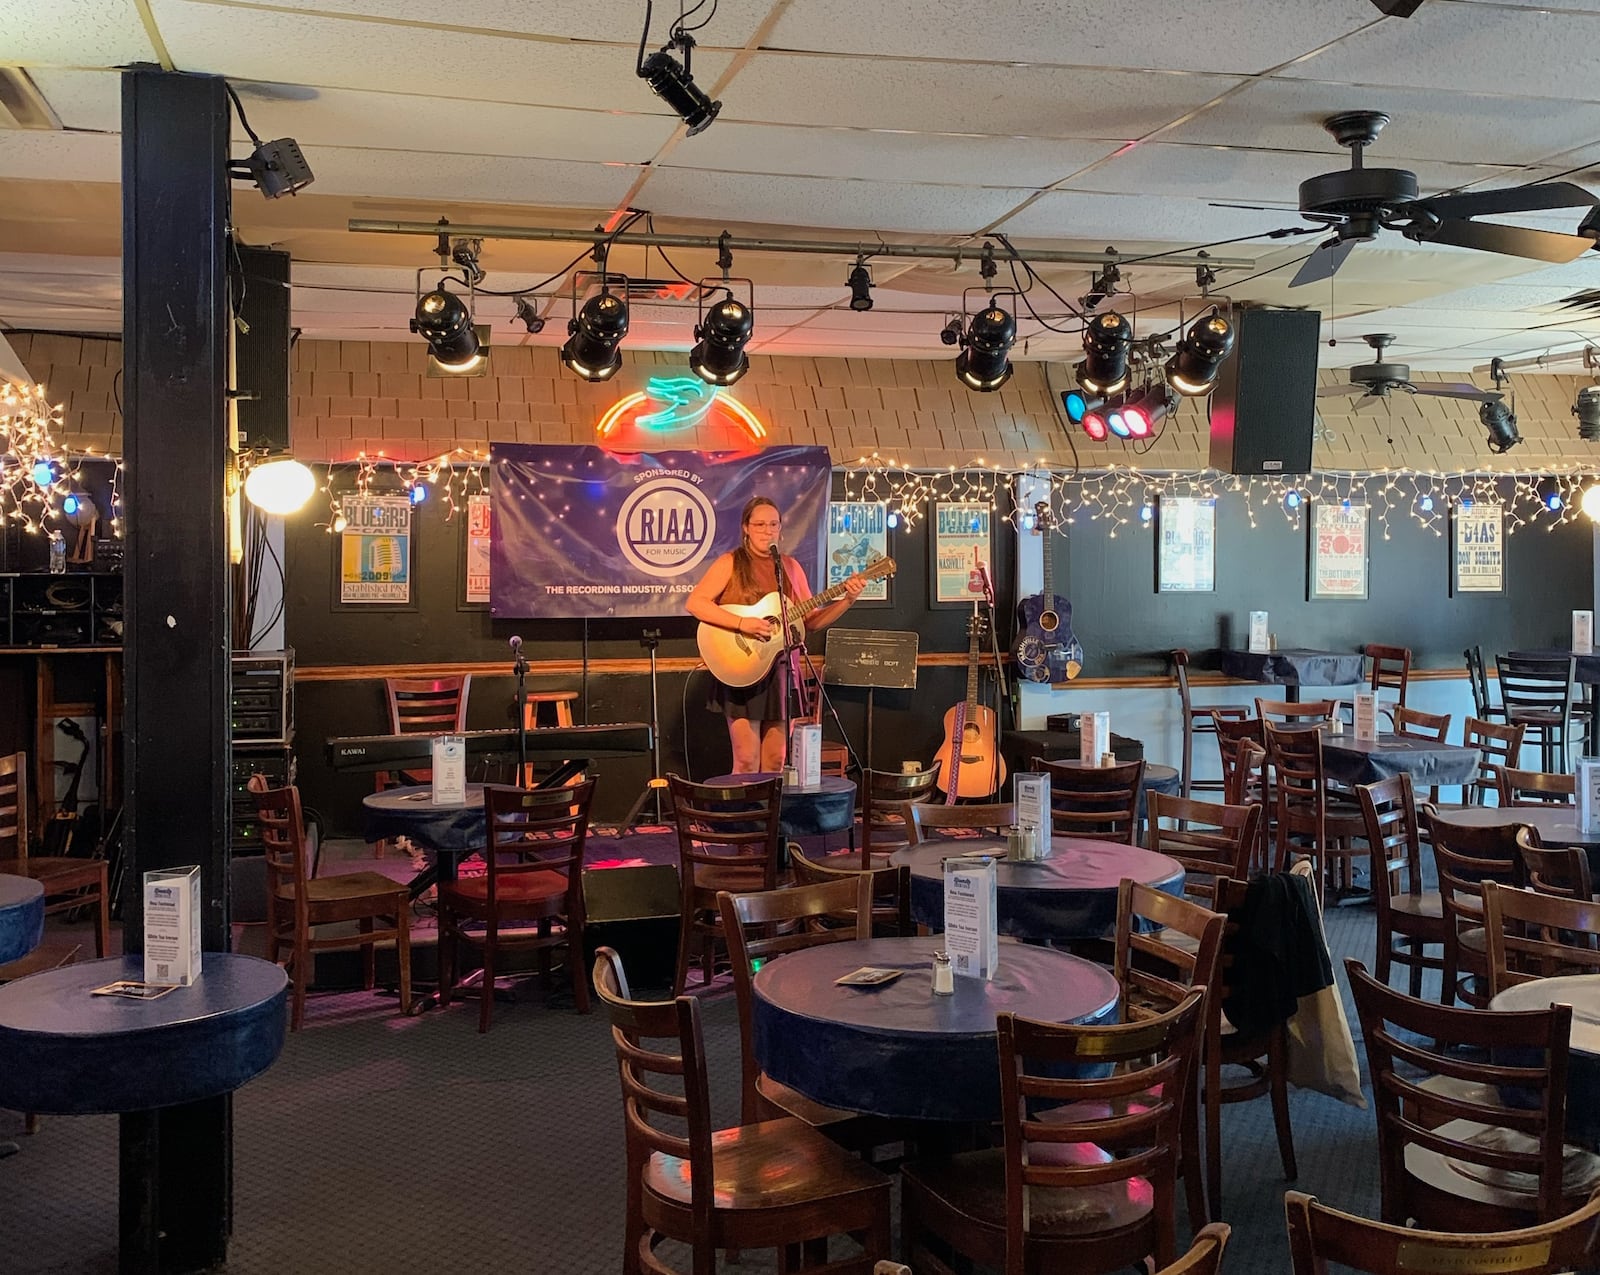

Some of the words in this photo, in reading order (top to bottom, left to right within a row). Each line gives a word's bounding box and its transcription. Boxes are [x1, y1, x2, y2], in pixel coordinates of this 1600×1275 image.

[633, 468, 691, 484] SPONSORED
[690, 473, 704, 486] BY
[641, 508, 695, 542] RIAA
[663, 548, 687, 556] MUSIC
[939, 557, 965, 570] NASHVILLE
[362, 572, 390, 581] 2009
[343, 583, 388, 593] Established
[391, 584, 408, 593] 1982
[545, 586, 564, 594] THE
[566, 586, 621, 594] RECORDING
[622, 585, 667, 593] INDUSTRY
[668, 585, 697, 593] ASSO
[341, 748, 366, 756] KAWAI
